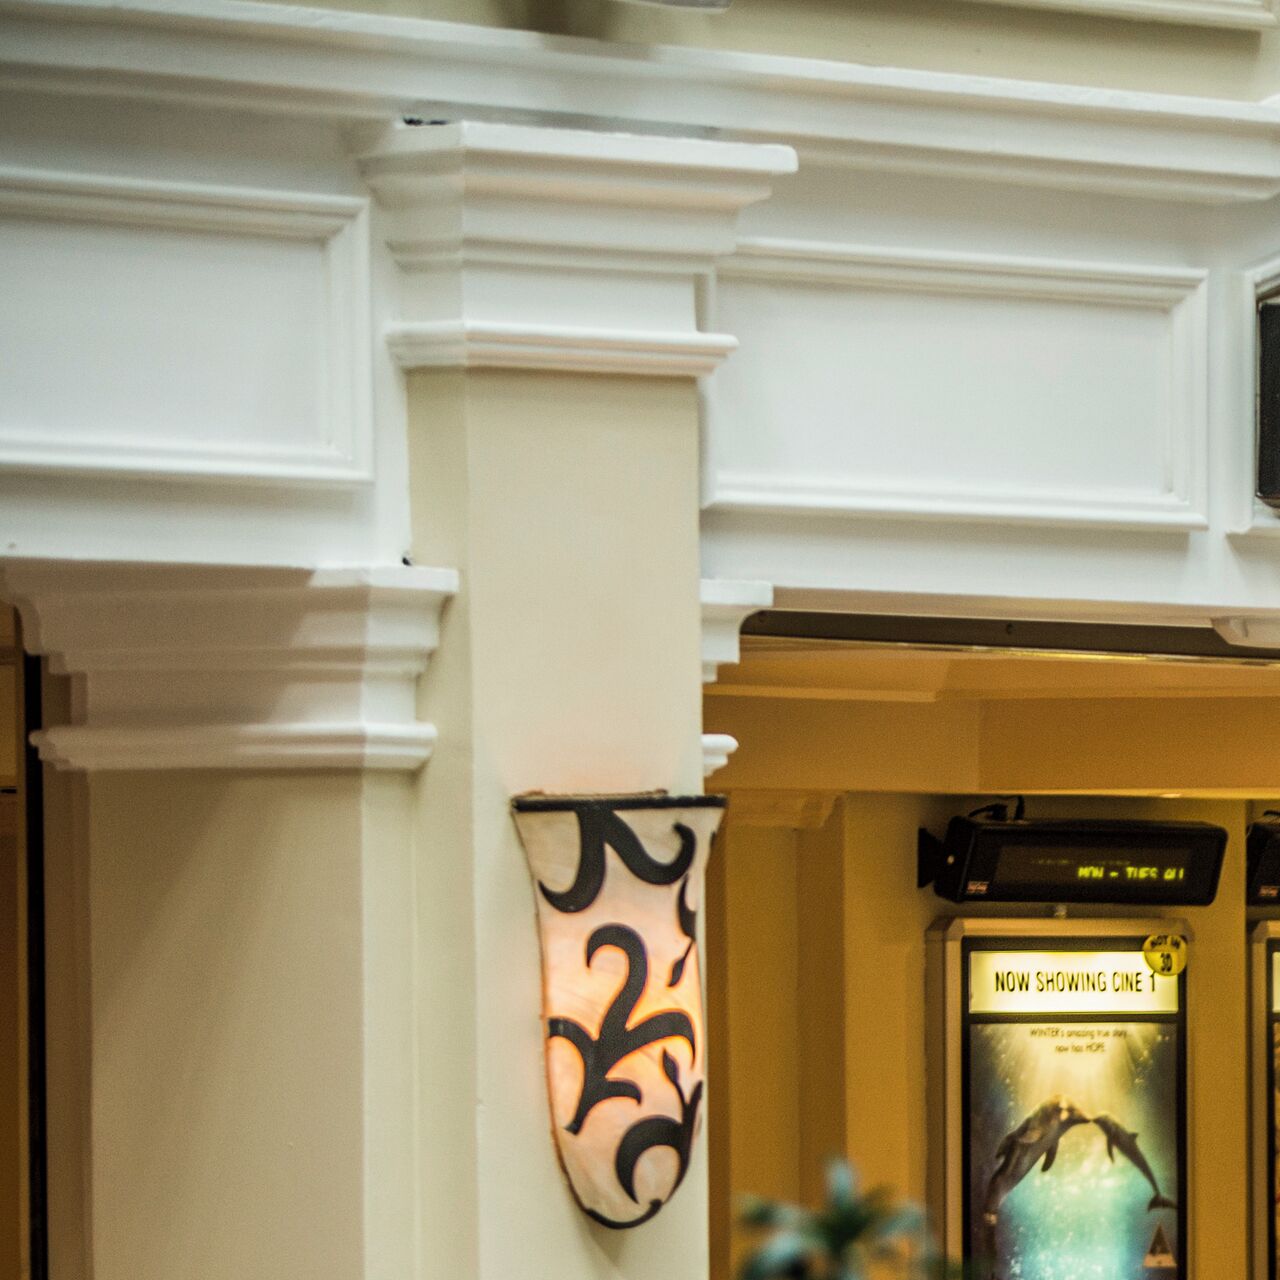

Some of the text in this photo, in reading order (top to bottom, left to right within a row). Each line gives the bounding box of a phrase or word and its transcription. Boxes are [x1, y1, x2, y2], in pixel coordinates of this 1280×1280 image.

[995, 970, 1156, 992] NOW SHOWING CINE 1
